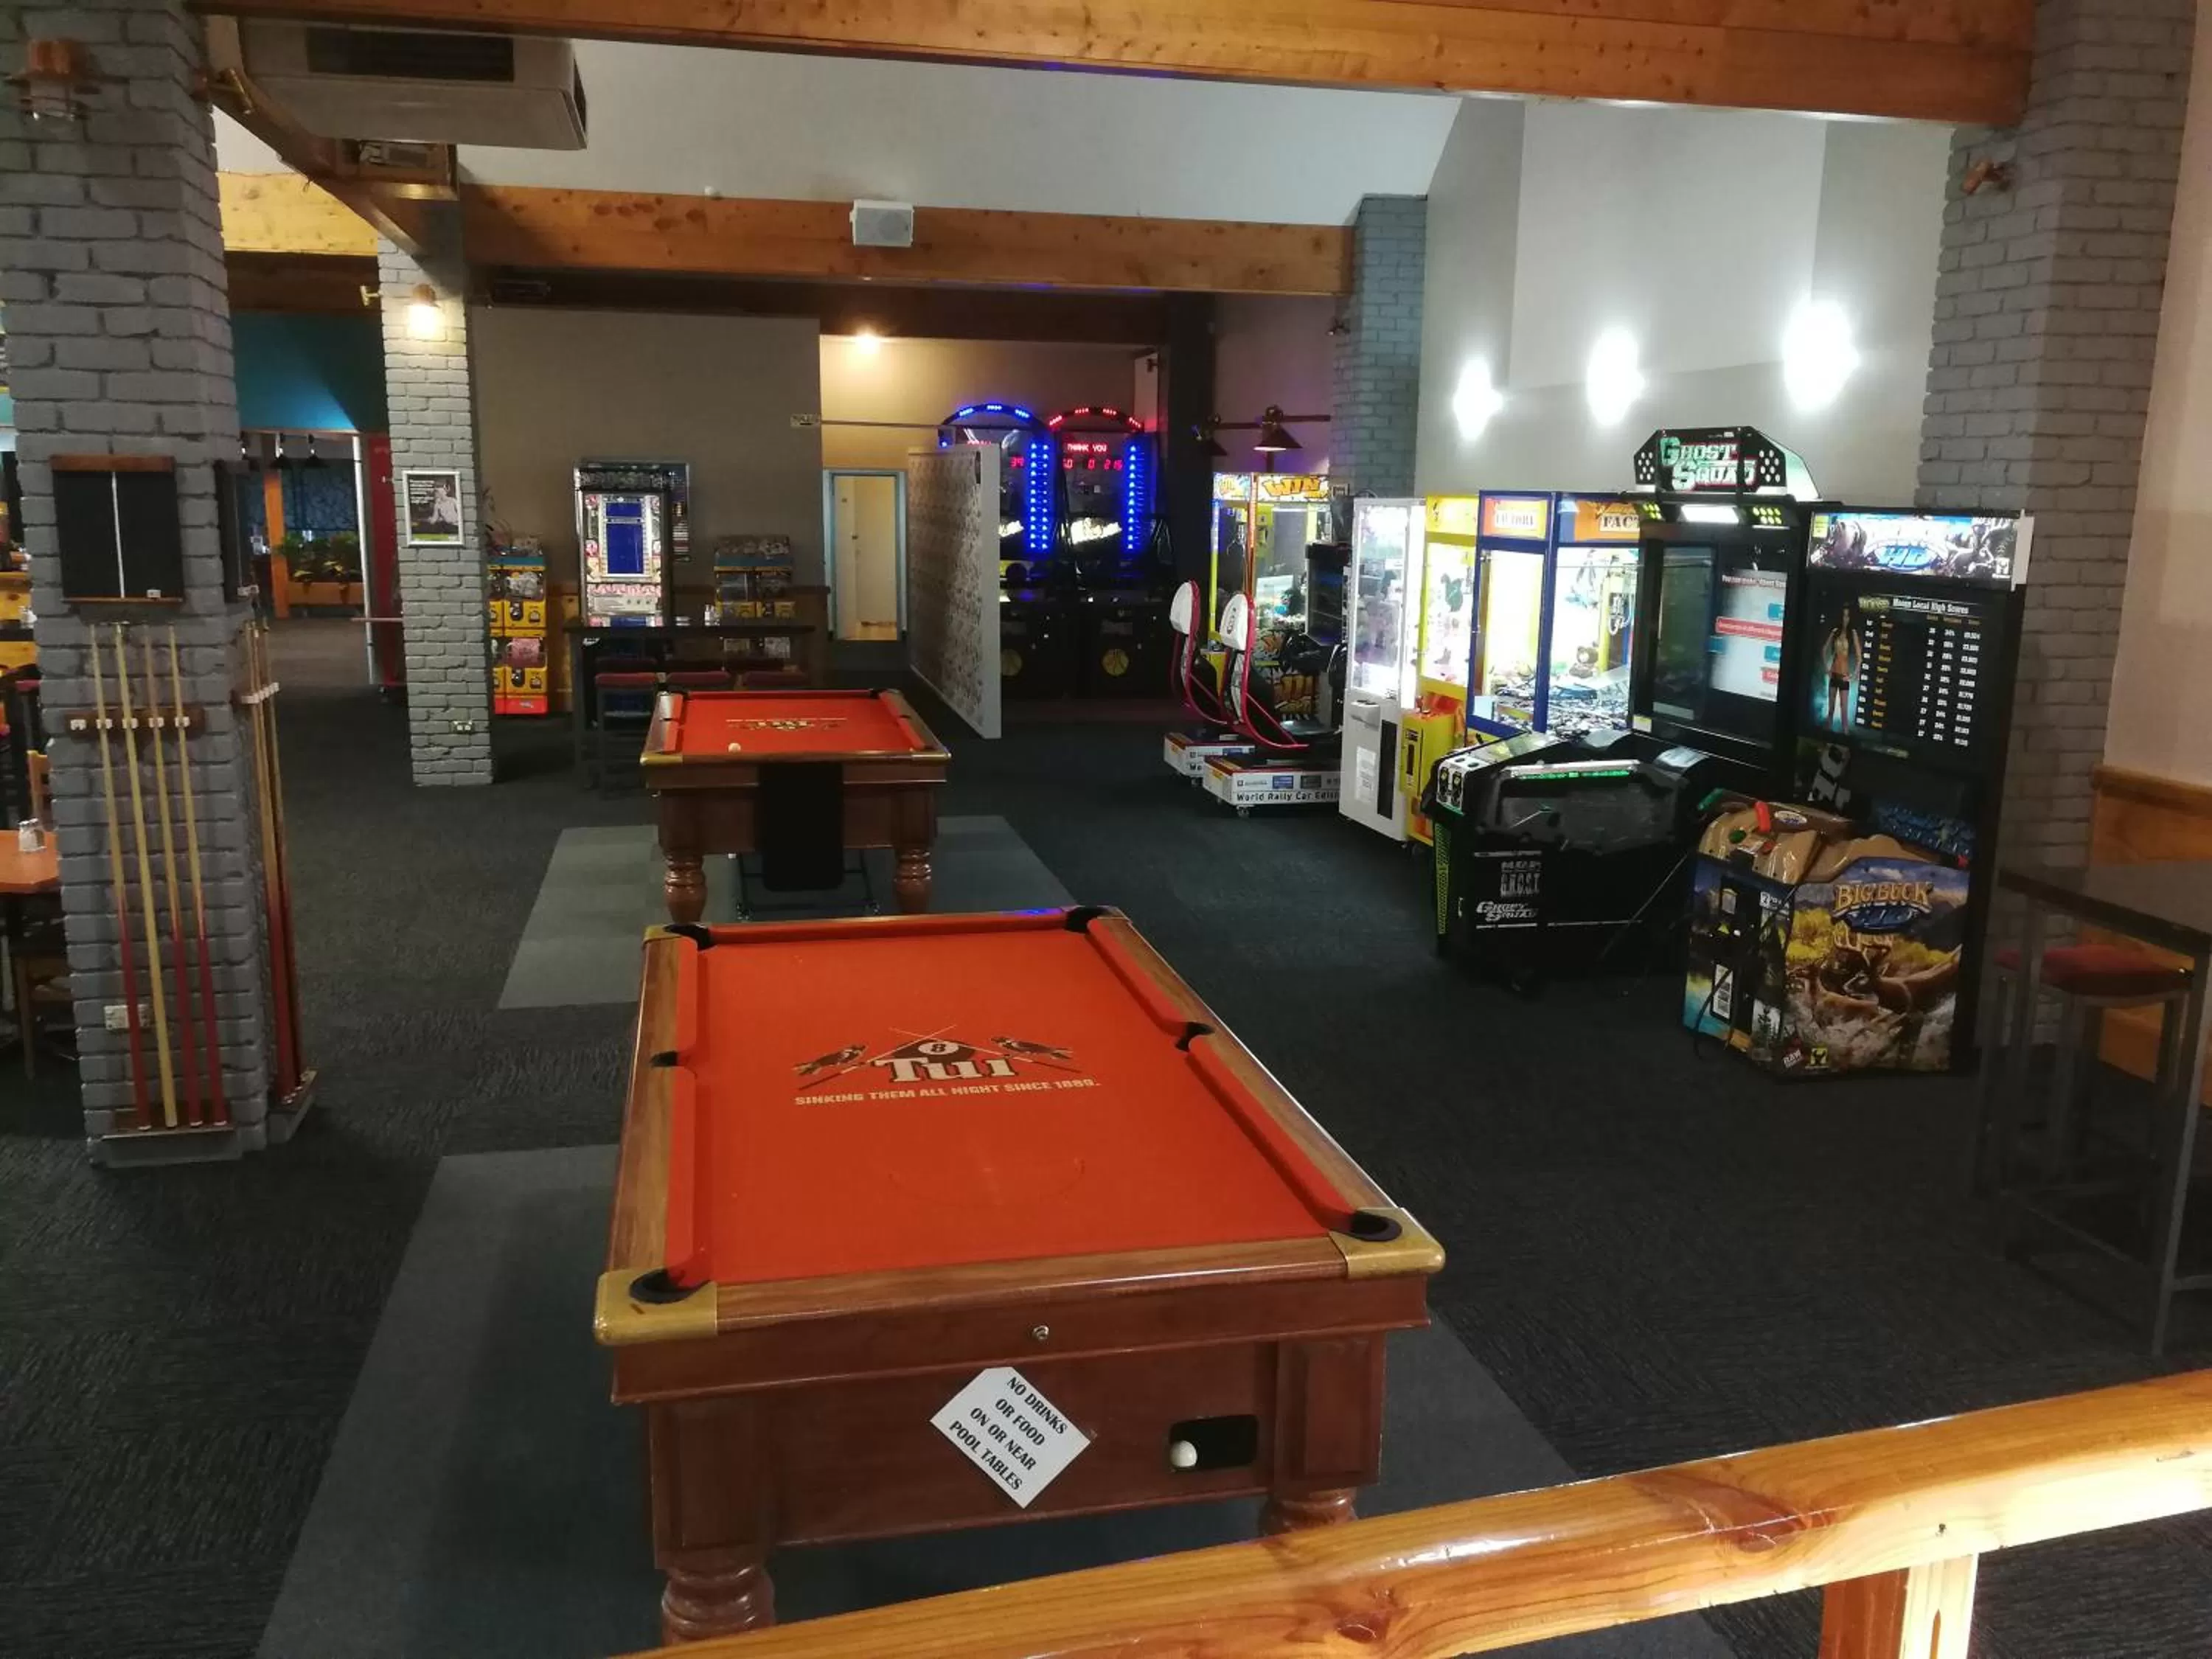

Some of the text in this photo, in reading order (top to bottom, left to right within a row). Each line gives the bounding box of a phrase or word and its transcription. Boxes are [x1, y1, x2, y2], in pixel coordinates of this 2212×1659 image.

[1067, 444, 1107, 452] THANK YOU
[1660, 437, 1738, 466] GHOST
[1913, 599, 1930, 610] Local
[1947, 604, 1969, 614] Scores
[1237, 793, 1265, 801] World
[1267, 792, 1292, 802] Rally
[1295, 791, 1312, 800] Car
[1833, 881, 1931, 911] BIG BUCK
[873, 1057, 1019, 1083] Tui
[795, 1093, 864, 1105] SINKING
[869, 1090, 916, 1101] THEM
[919, 1087, 947, 1098] ALL
[951, 1084, 999, 1096] NIGHT
[1004, 1080, 1052, 1093] SINCE
[1006, 1377, 1068, 1435] NO DRINKS
[995, 1398, 1046, 1446] OR FOOD
[970, 1407, 1037, 1470] ON OR NEAR
[949, 1420, 1023, 1490] POOL TABLES
